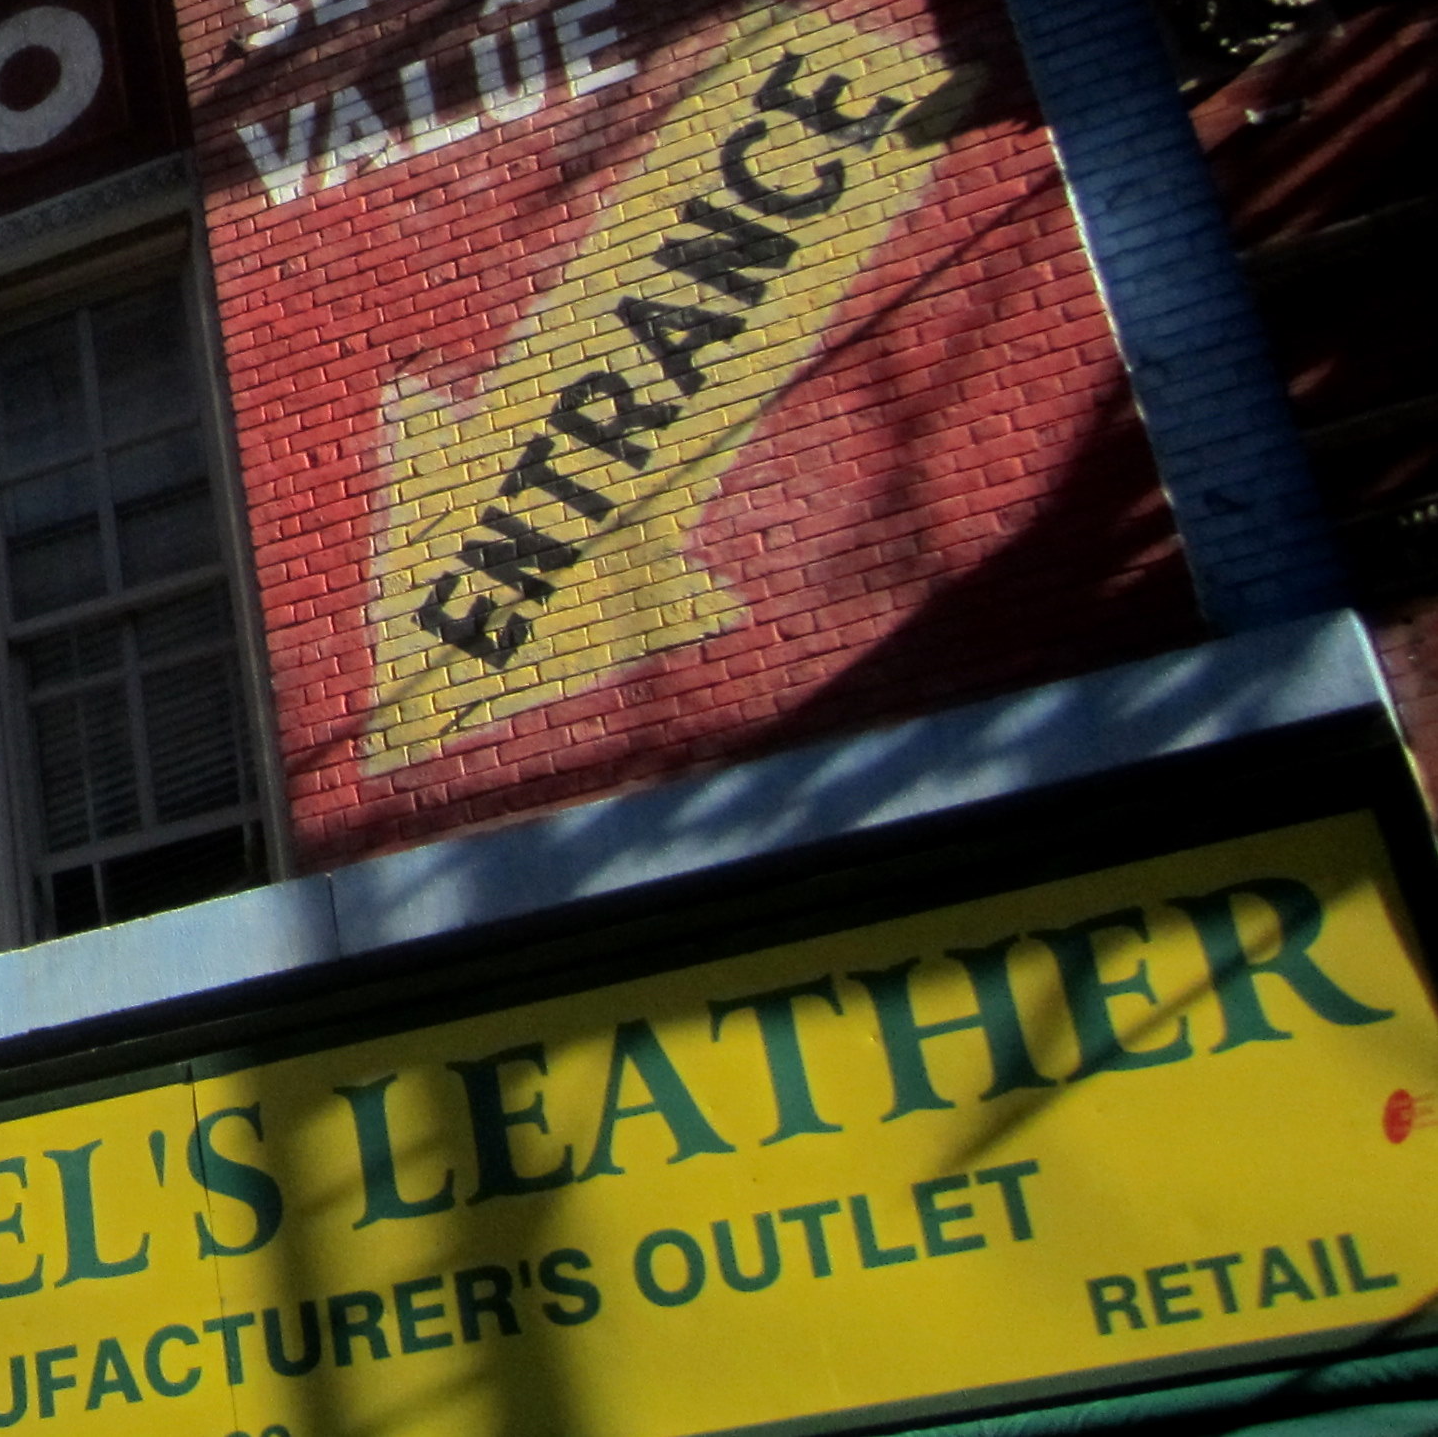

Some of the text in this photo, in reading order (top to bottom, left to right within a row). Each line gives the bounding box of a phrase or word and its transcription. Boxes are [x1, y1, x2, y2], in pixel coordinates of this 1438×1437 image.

[411, 52, 908, 671] ENTRANCE
[334, 876, 1395, 1231] LEATHER
[633, 1160, 1042, 1307] OUTLET
[1084, 1232, 1399, 1336] RETAIL
